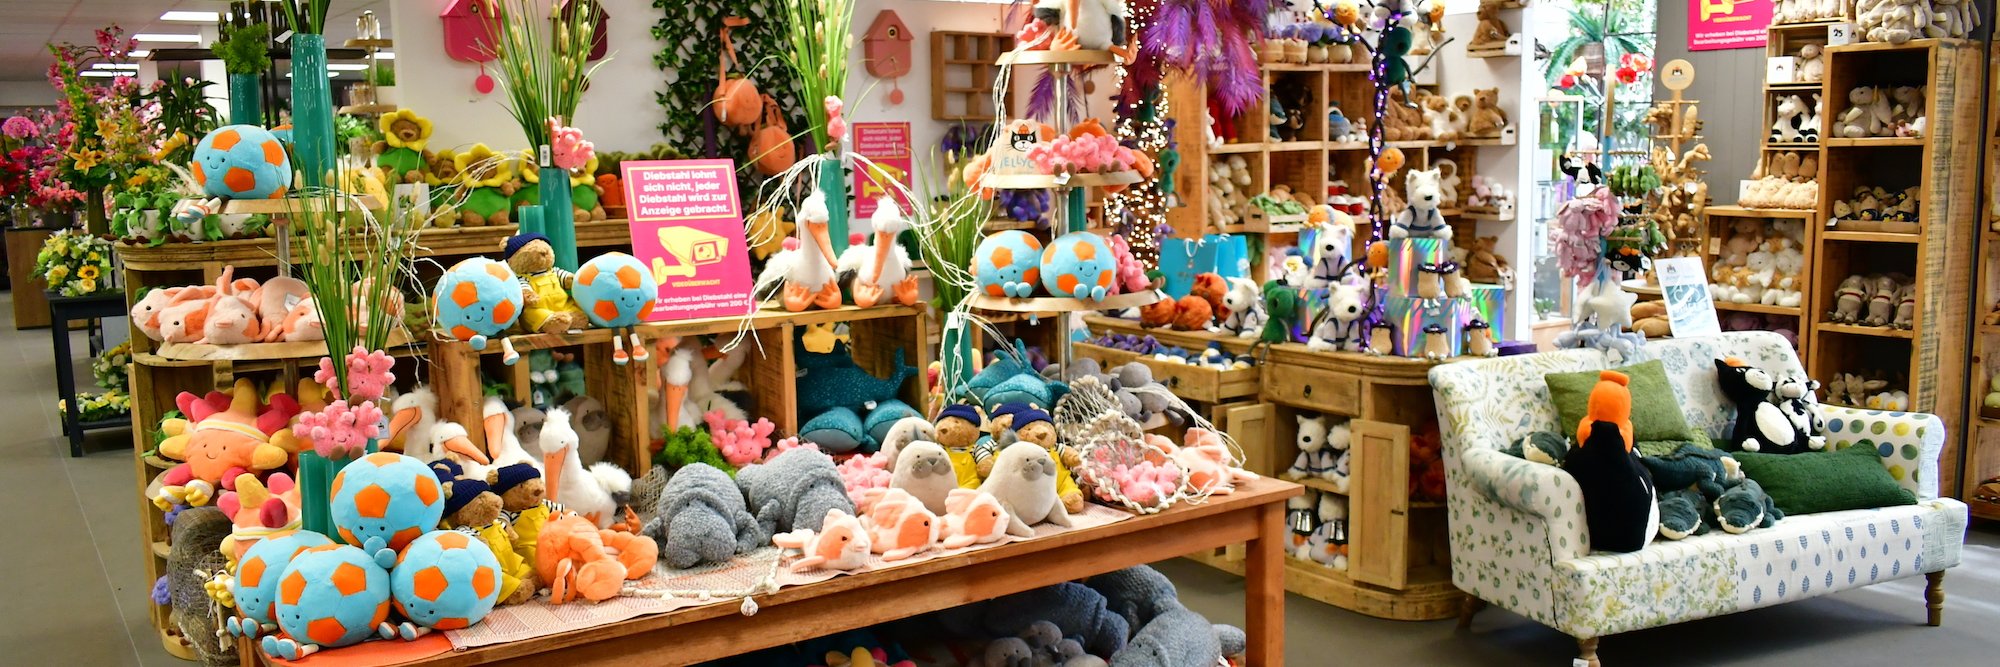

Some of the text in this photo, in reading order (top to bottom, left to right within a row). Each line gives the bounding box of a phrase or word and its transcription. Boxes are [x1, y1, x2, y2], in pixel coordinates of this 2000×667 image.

[1000, 155, 1034, 168] JELLYC
[643, 170, 717, 180] Diebstahl lohnt
[643, 181, 720, 192] sich nicht, jeder
[639, 193, 727, 204] Diebstahl wird zur
[641, 204, 730, 216] Anzeige gebracht.
[663, 296, 691, 304] erheben
[702, 293, 733, 301] Diebstahl
[653, 303, 716, 312] earbeitungsgebühr
